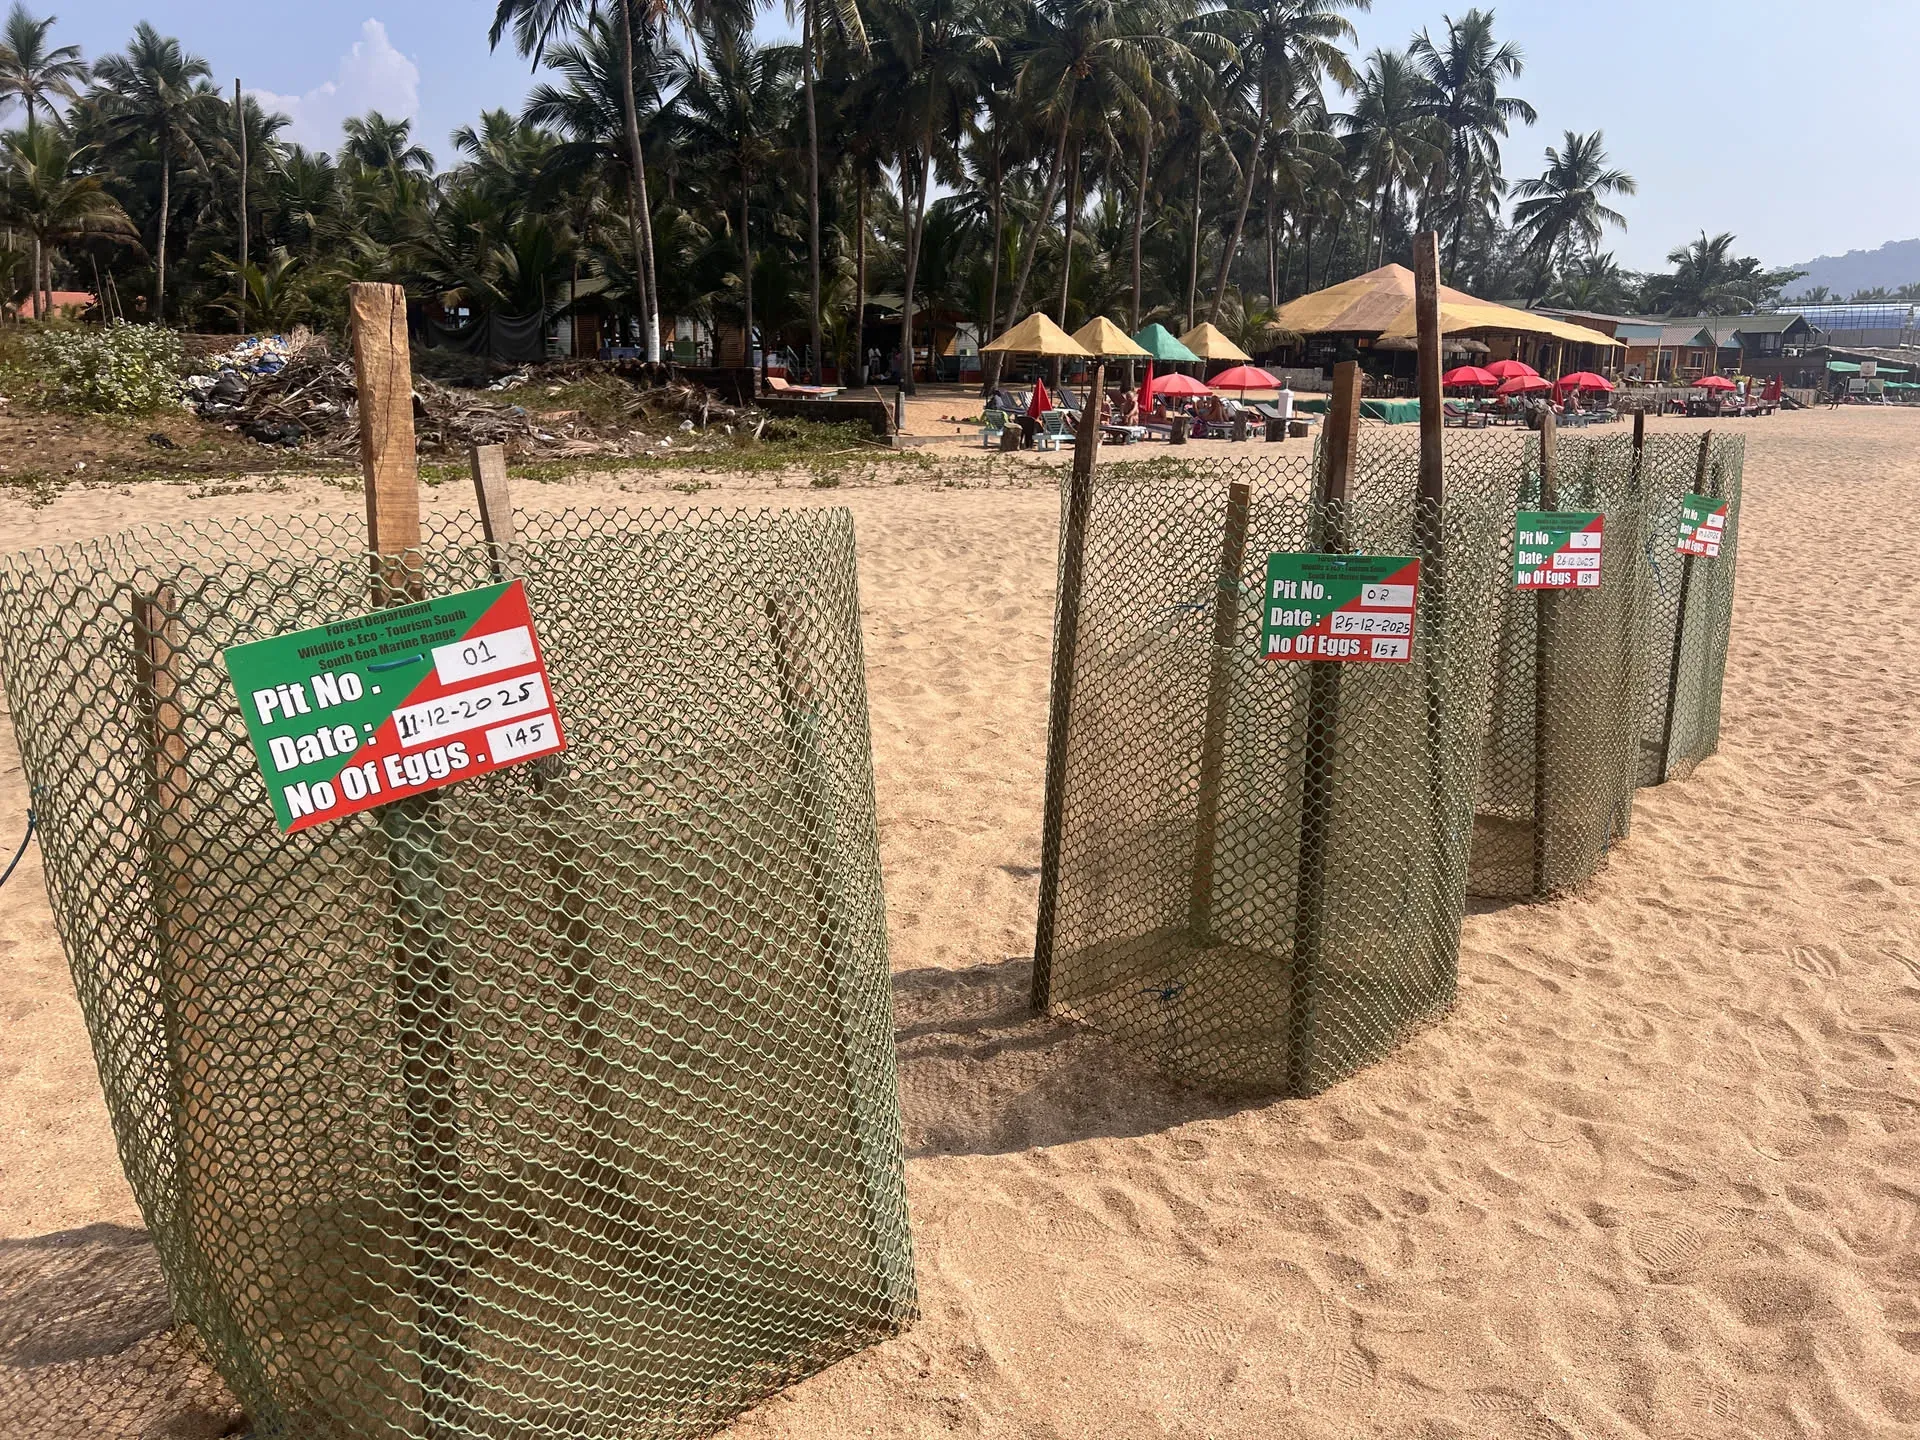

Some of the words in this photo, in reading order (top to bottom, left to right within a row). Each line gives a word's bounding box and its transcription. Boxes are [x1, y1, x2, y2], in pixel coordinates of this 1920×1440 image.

[1520, 531, 1533, 545] Pit
[1582, 534, 1589, 546] 3
[1272, 580, 1297, 599] Pit
[1367, 589, 1389, 601] 02
[1517, 570, 1531, 584] No
[1533, 570, 1544, 584] Of
[325, 619, 364, 636] Forest
[364, 602, 432, 626] Department
[1335, 615, 1410, 634] 25-12-2025
[298, 638, 345, 659] Wildlife
[347, 637, 356, 647] &
[357, 632, 378, 646] Eco
[384, 618, 432, 638] Tourism
[433, 609, 467, 625] South
[1268, 634, 1291, 653] No
[1295, 635, 1315, 654] Of
[1375, 642, 1398, 657] 157
[319, 654, 353, 670] South
[355, 647, 378, 661] Goa
[379, 637, 419, 655] Marine
[420, 628, 456, 645] Range
[252, 681, 311, 725] Pit
[463, 640, 496, 665] 01
[283, 781, 337, 820] No
[339, 763, 378, 800] Of
[506, 723, 544, 748] 145
